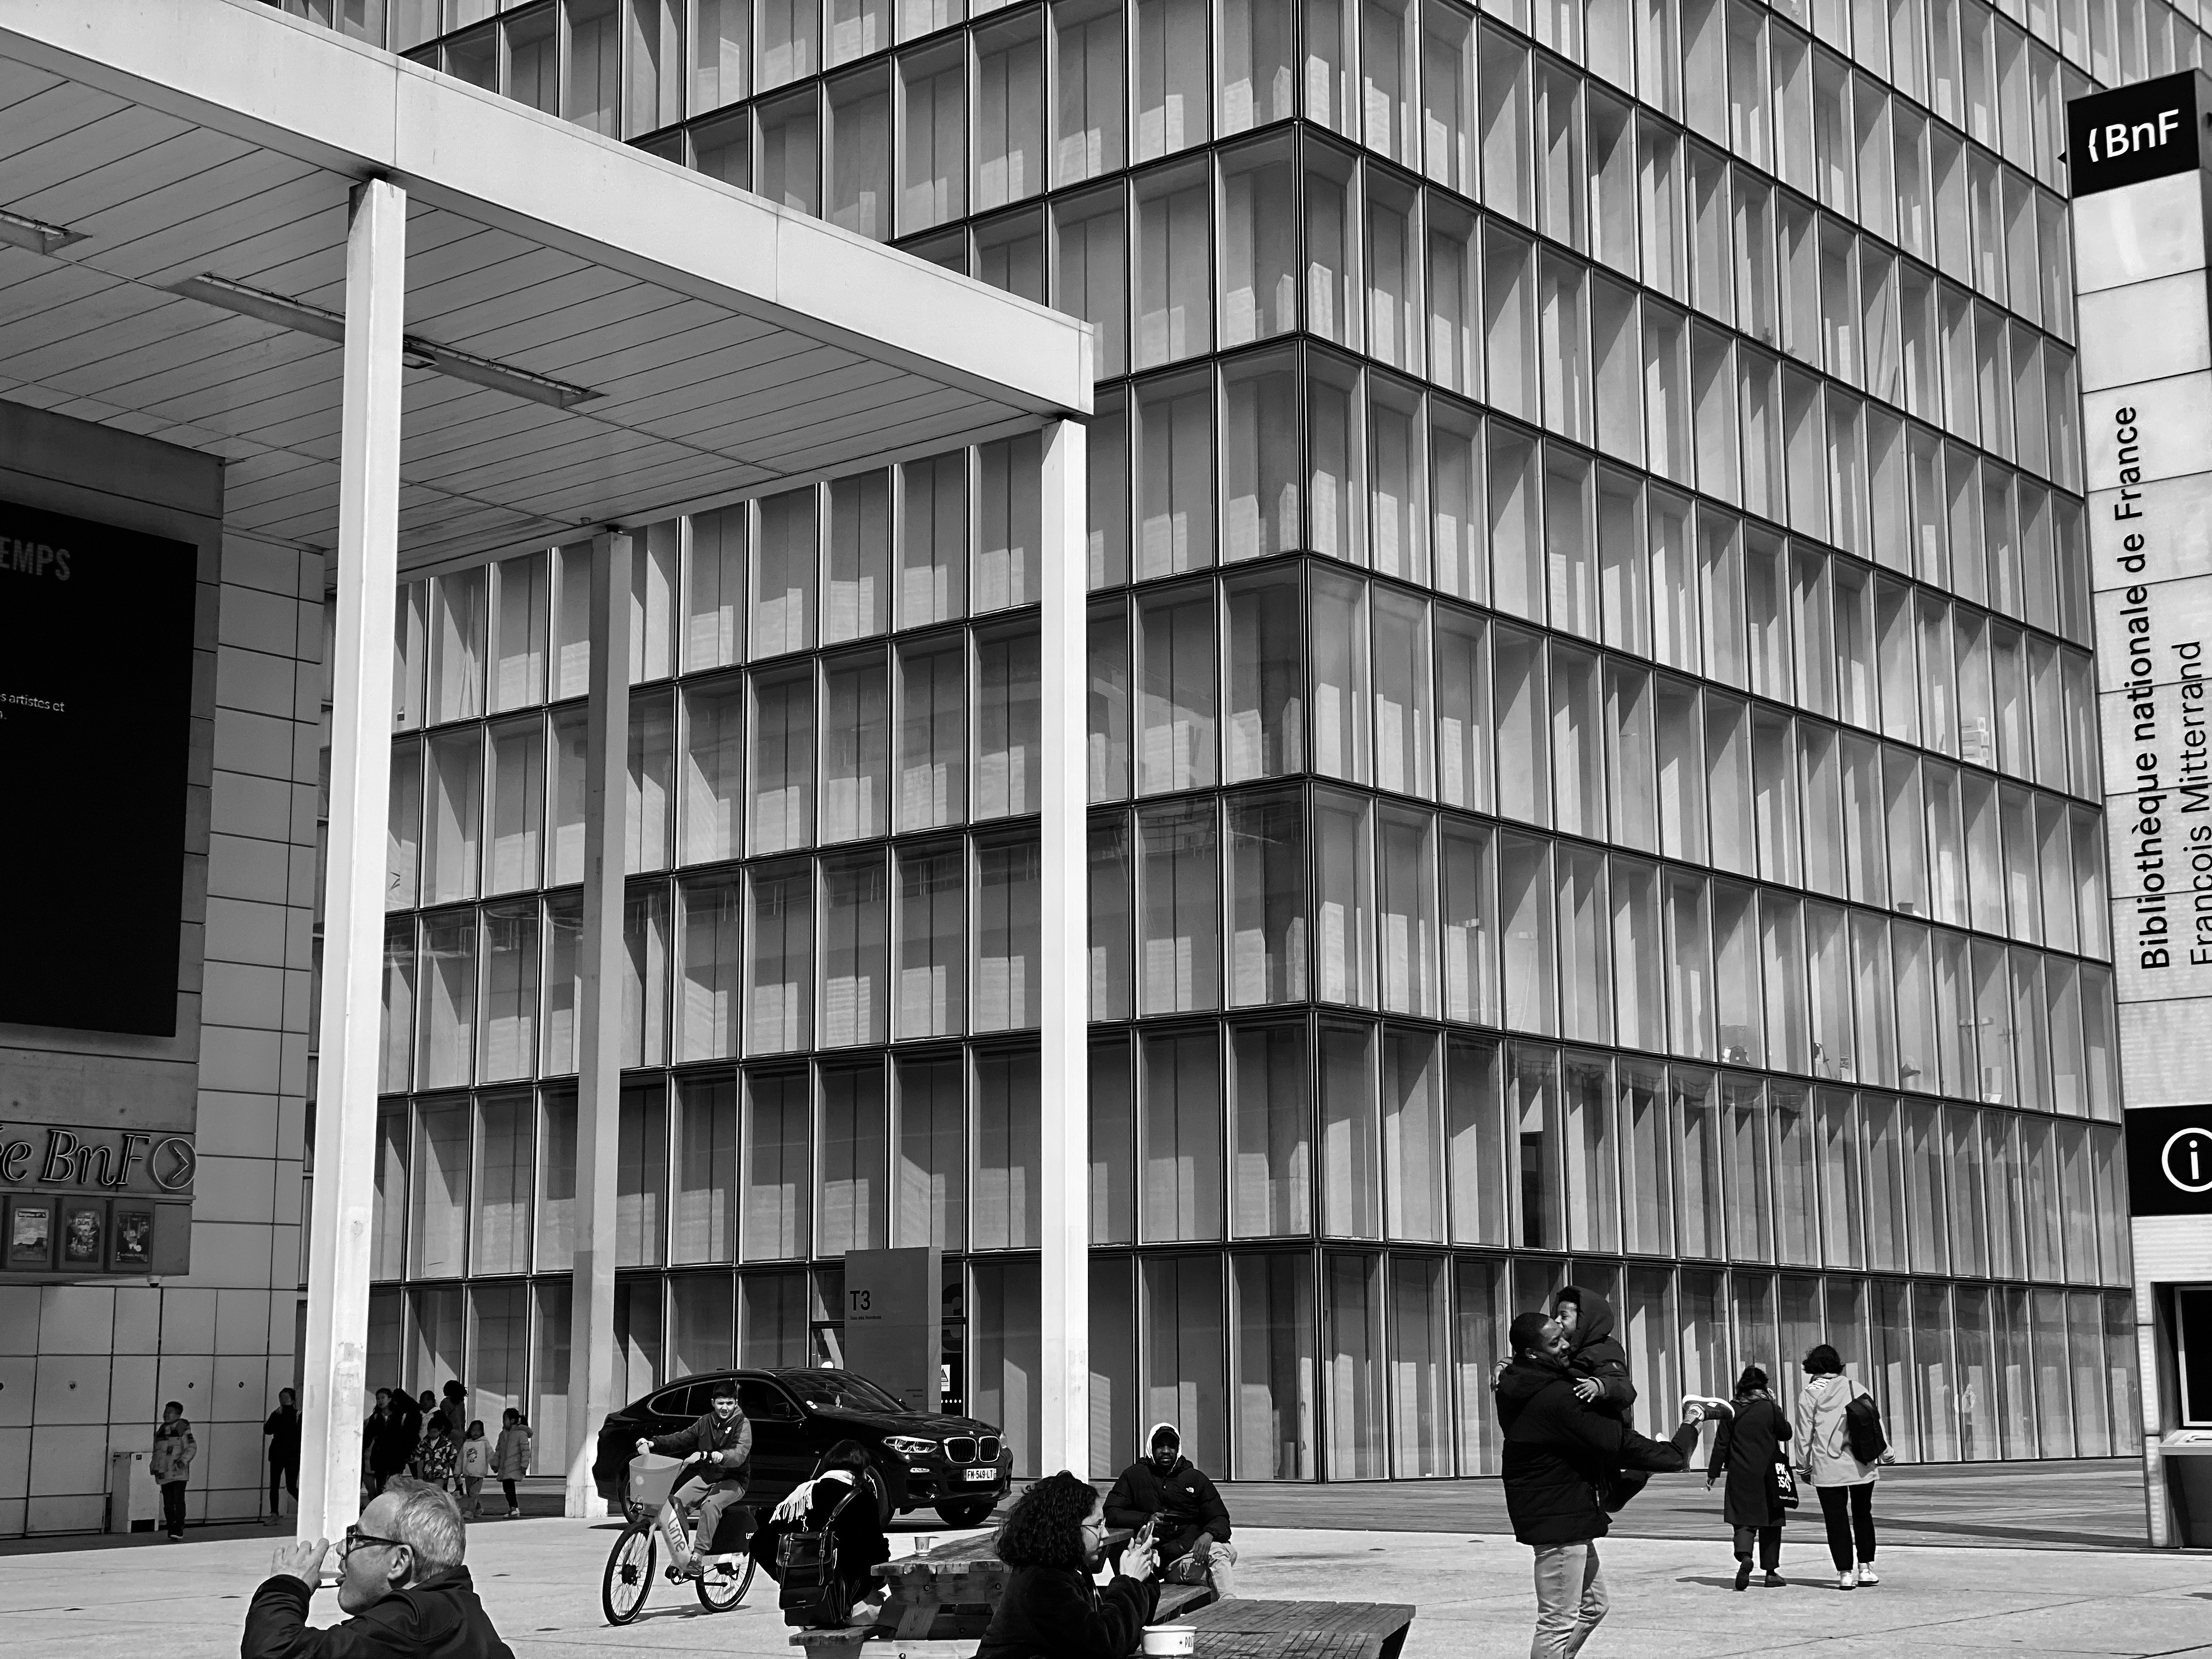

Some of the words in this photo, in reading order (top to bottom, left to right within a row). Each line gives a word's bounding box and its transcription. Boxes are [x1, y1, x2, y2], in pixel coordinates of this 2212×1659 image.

[2114, 407, 2142, 521] France
[2117, 533, 2146, 573] de
[9, 694, 50, 710] artistes
[53, 702, 65, 712] et
[2120, 586, 2155, 741] nationale
[2171, 641, 2210, 813] Mitterrand
[2131, 752, 2170, 969] Bibliothèque
[38, 1128, 151, 1186] BnF
[849, 1290, 871, 1311] T3
